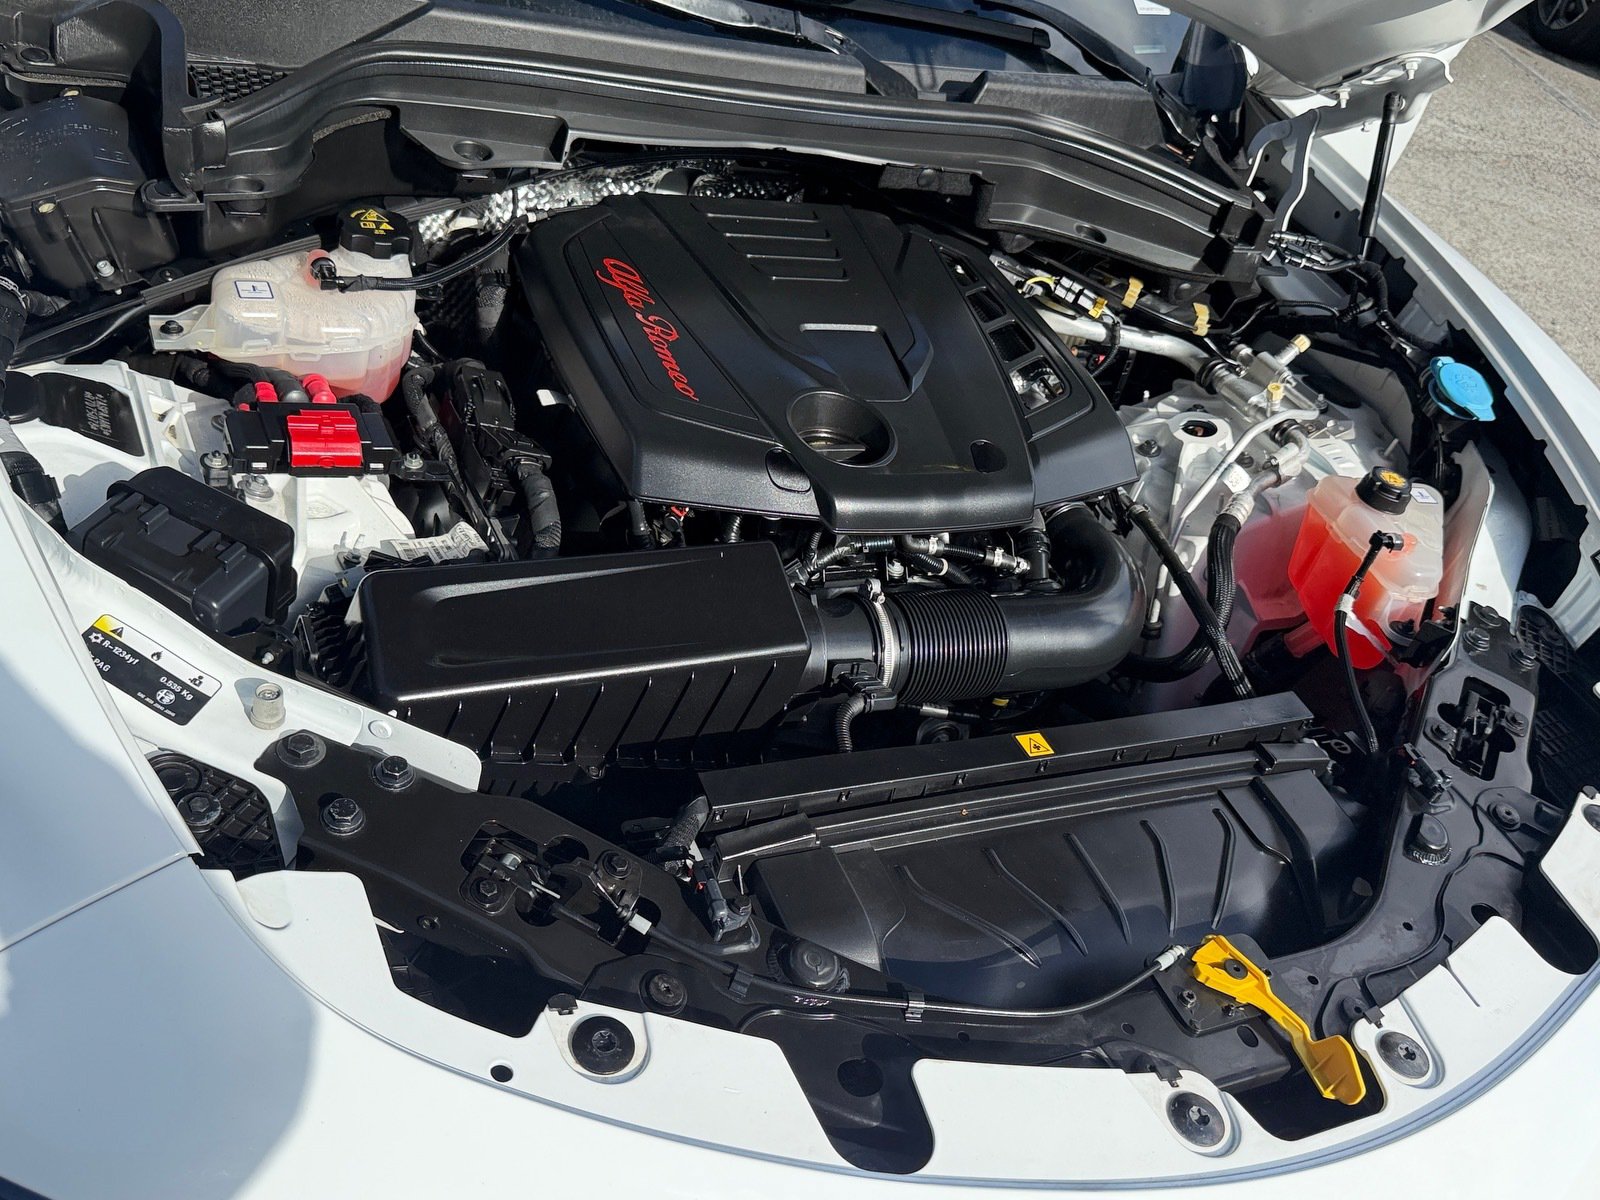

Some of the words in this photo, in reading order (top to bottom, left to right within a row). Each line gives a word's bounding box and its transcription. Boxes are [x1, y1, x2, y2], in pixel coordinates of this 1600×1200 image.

[596, 257, 655, 313] Alfa
[635, 312, 700, 401] Romeo
[102, 640, 139, 665] R-1234yf
[93, 657, 111, 672] PAG
[181, 688, 193, 700] Kg
